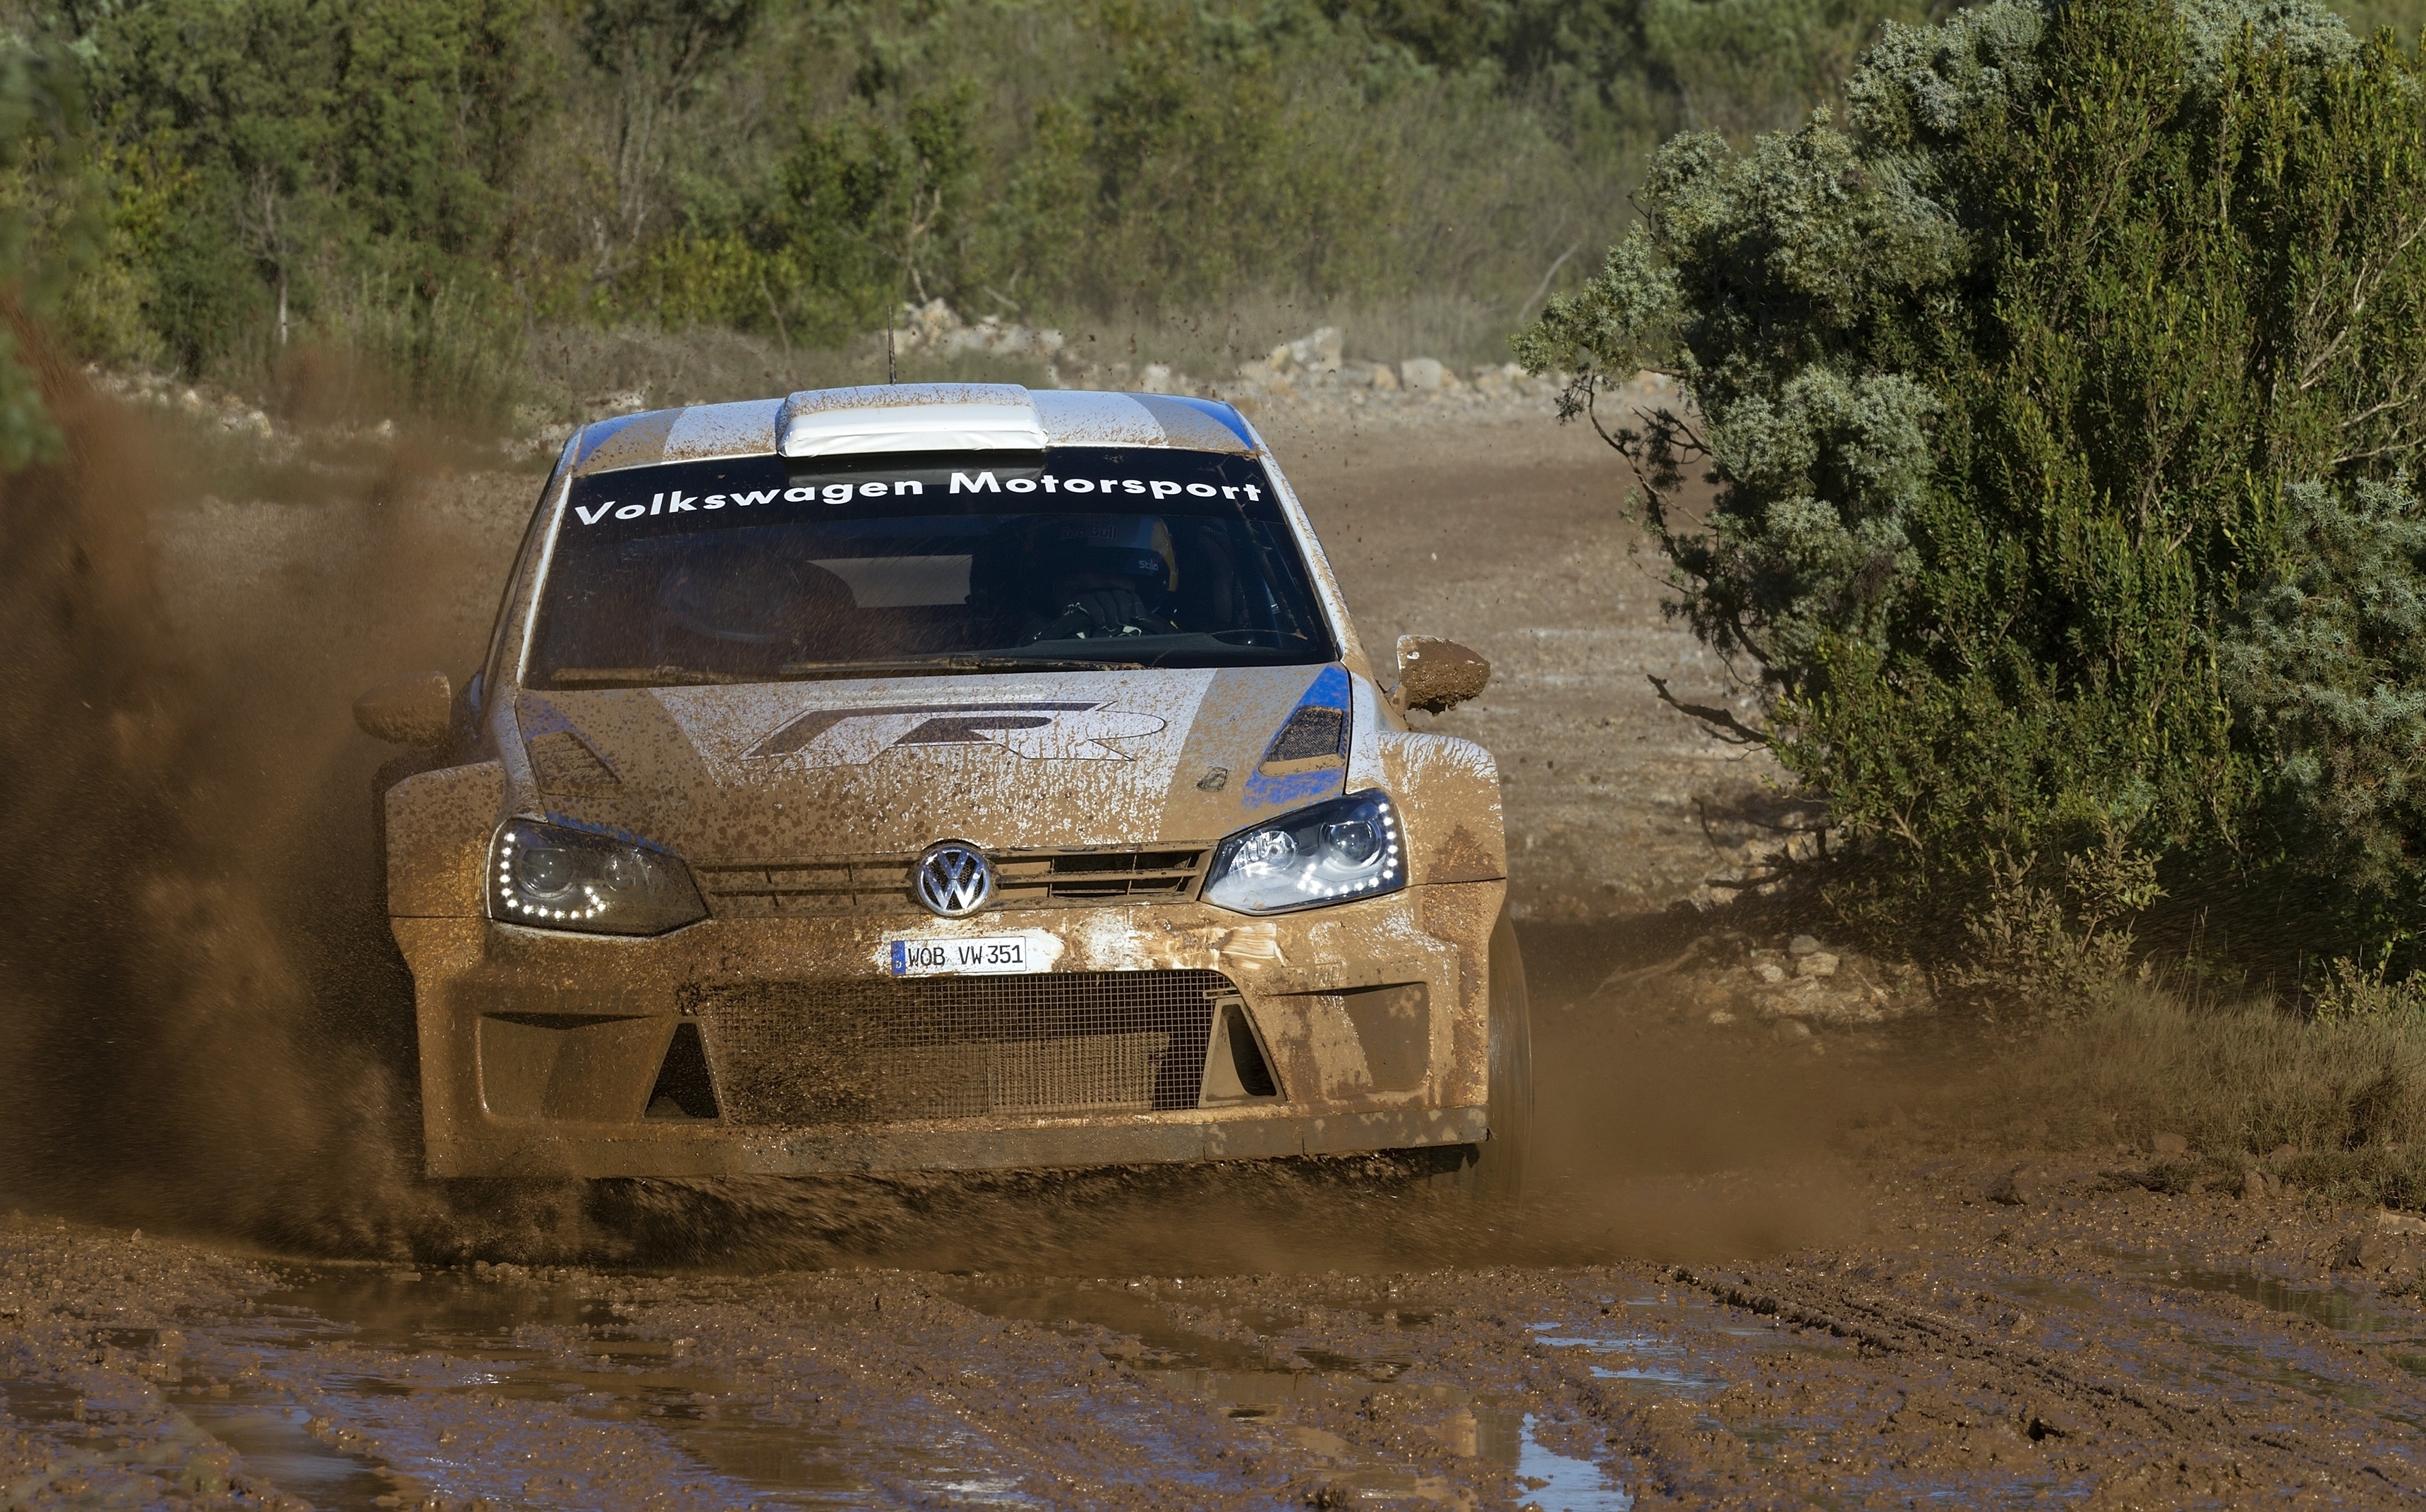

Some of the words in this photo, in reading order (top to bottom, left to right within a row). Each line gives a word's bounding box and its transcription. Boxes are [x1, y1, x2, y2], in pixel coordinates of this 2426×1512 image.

[574, 480, 923, 526] Volkswagen
[948, 471, 1261, 502] Motorsport
[1088, 524, 1118, 540] Bull
[918, 846, 989, 916] VW
[958, 945, 983, 965] VW
[987, 944, 1023, 964] 351
